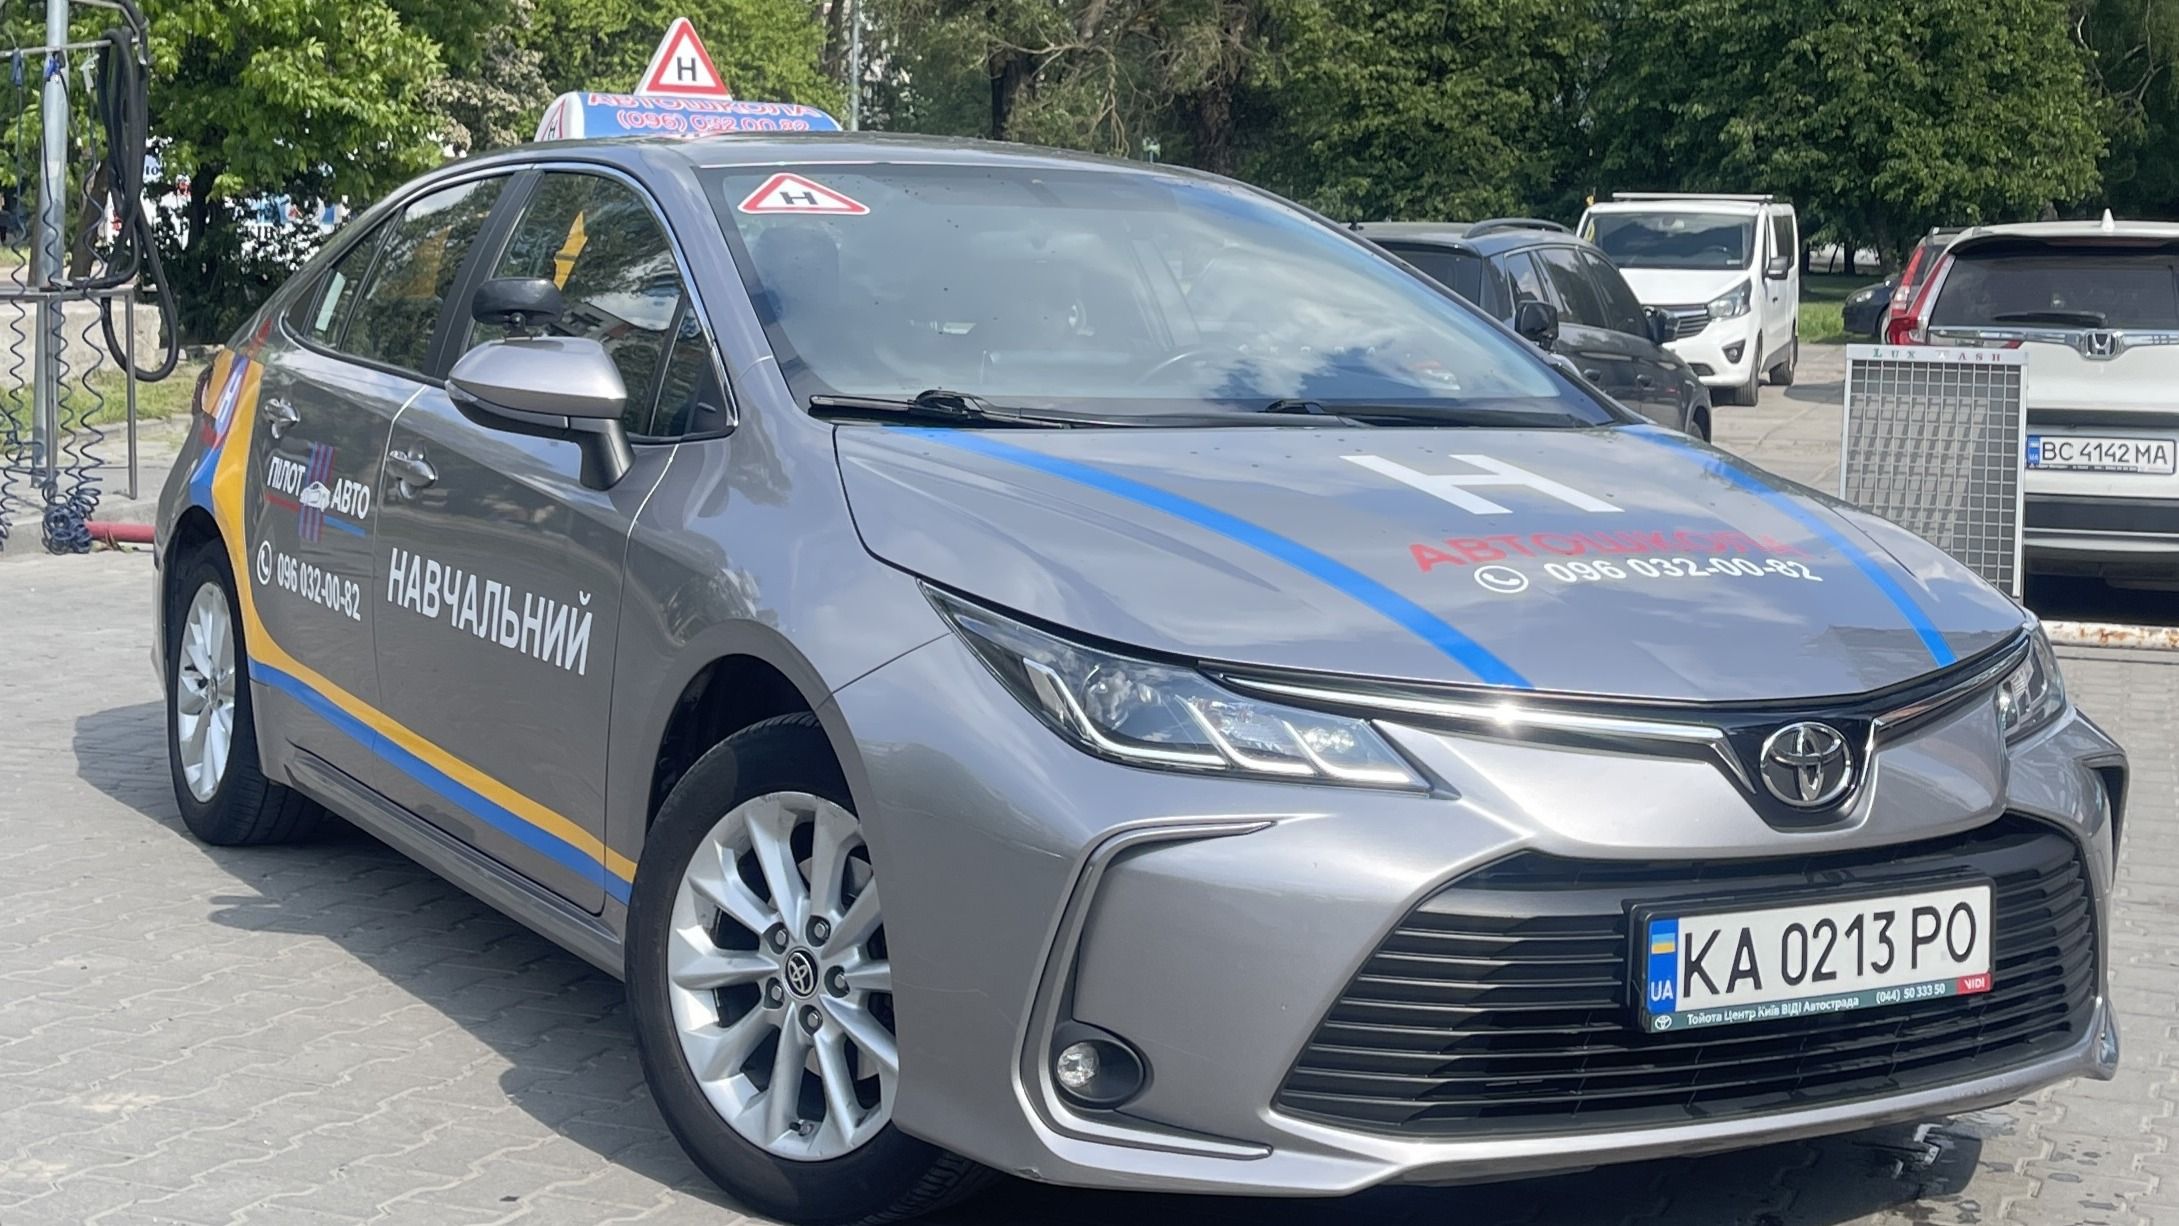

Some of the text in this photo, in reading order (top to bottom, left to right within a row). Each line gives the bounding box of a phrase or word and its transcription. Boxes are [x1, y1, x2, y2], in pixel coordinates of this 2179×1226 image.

[676, 57, 697, 81] Н
[616, 109, 688, 132] (096)
[690, 113, 739, 132] 032
[779, 191, 819, 206] Н
[1936, 350, 2001, 362] WASH
[2042, 441, 2168, 465] BC 4142 MA
[266, 455, 370, 520] ПІЛОТ АВТО
[1339, 454, 1625, 514] Н
[1407, 529, 1813, 573] АВТОШКОЛА
[1543, 557, 1824, 583] 096 032-00-82
[277, 552, 361, 621] 096 032-00-82
[387, 547, 593, 675] НАВЧАЛЬНИЙ
[1683, 901, 1977, 998] KA 0213 PO
[1650, 980, 1674, 1001] UA
[1875, 983, 1946, 1005] (044) 50 333 50
[1963, 977, 1985, 990] VIDI
[1686, 996, 1860, 1026] Тойота Центр Київ ВІДІ Автострада
